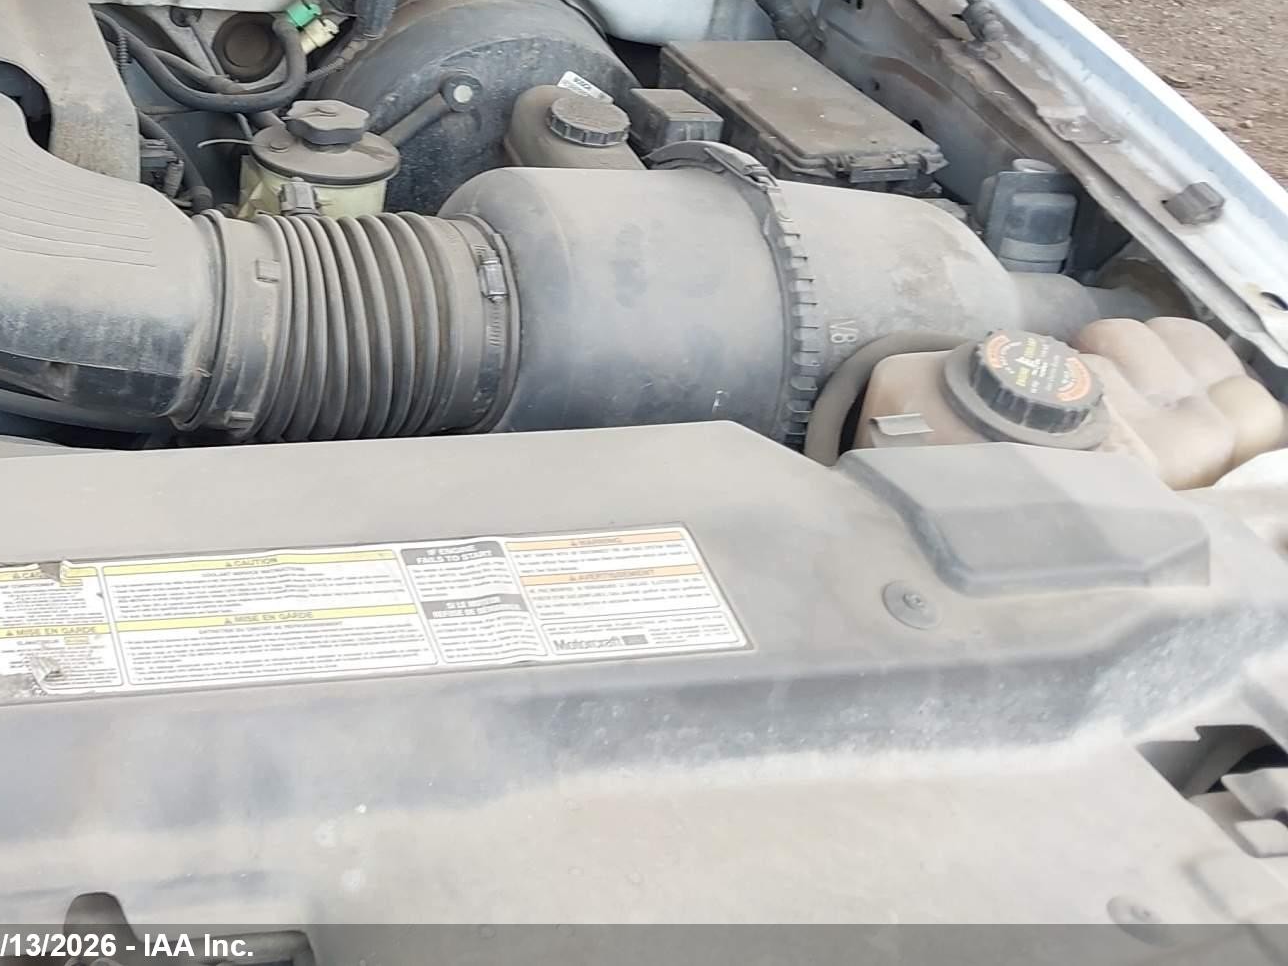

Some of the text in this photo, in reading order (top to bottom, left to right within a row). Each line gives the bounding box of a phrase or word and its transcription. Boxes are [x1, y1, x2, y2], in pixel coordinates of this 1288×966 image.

[829, 320, 860, 344] V8
[233, 557, 278, 567] CAUTION
[416, 550, 493, 564] FAILS TO START
[234, 611, 313, 623] MISE EN GARDE
[16, 627, 41, 635] MISE
[61, 626, 96, 634] GARDE
[552, 636, 620, 651] Motorcraft
